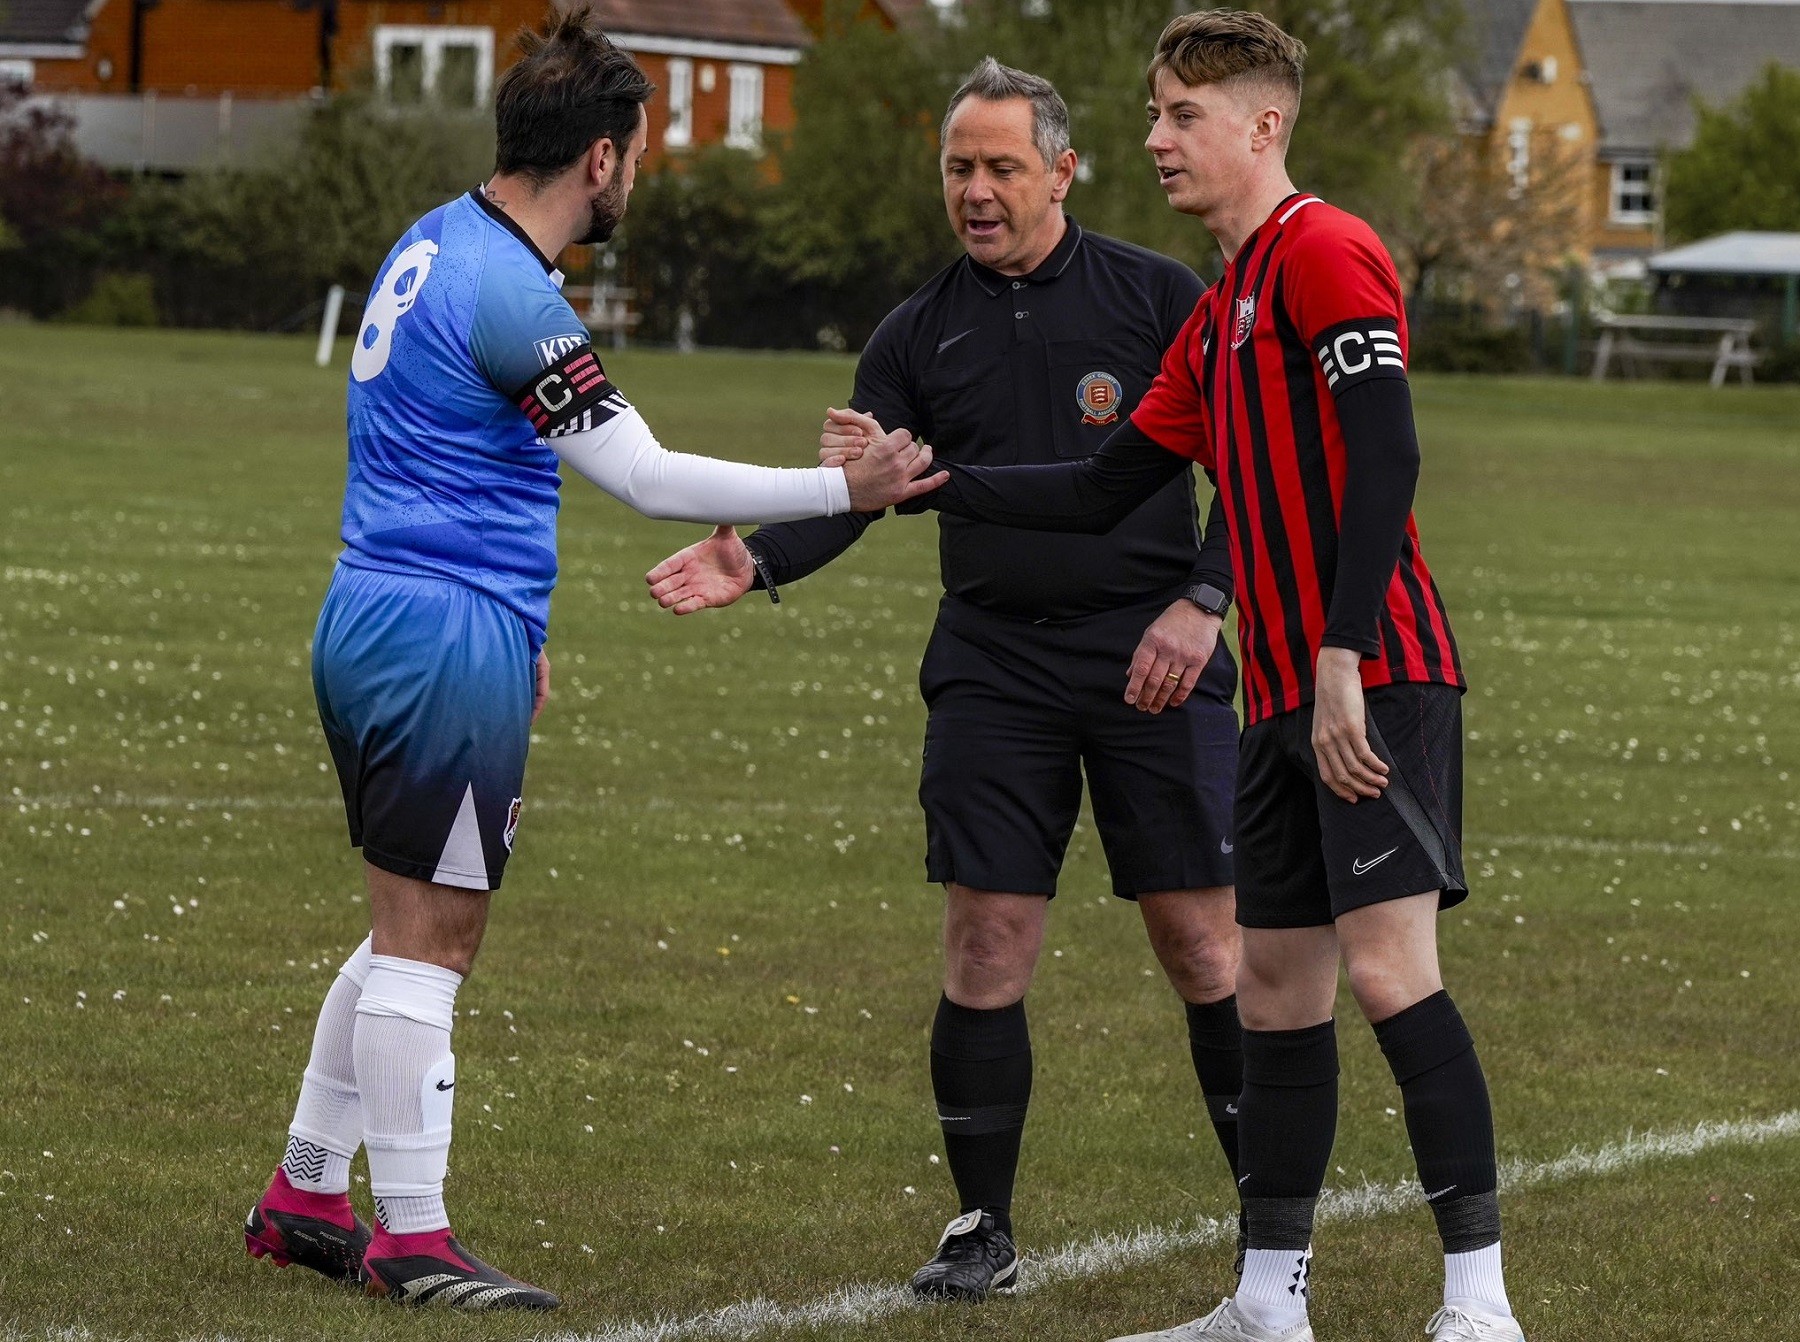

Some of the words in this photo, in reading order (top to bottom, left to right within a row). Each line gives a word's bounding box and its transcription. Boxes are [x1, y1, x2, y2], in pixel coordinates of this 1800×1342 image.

[352, 240, 438, 382] 8
[1334, 331, 1371, 375] C
[535, 374, 573, 412] C
[1097, 373, 1117, 384] COUNTY
